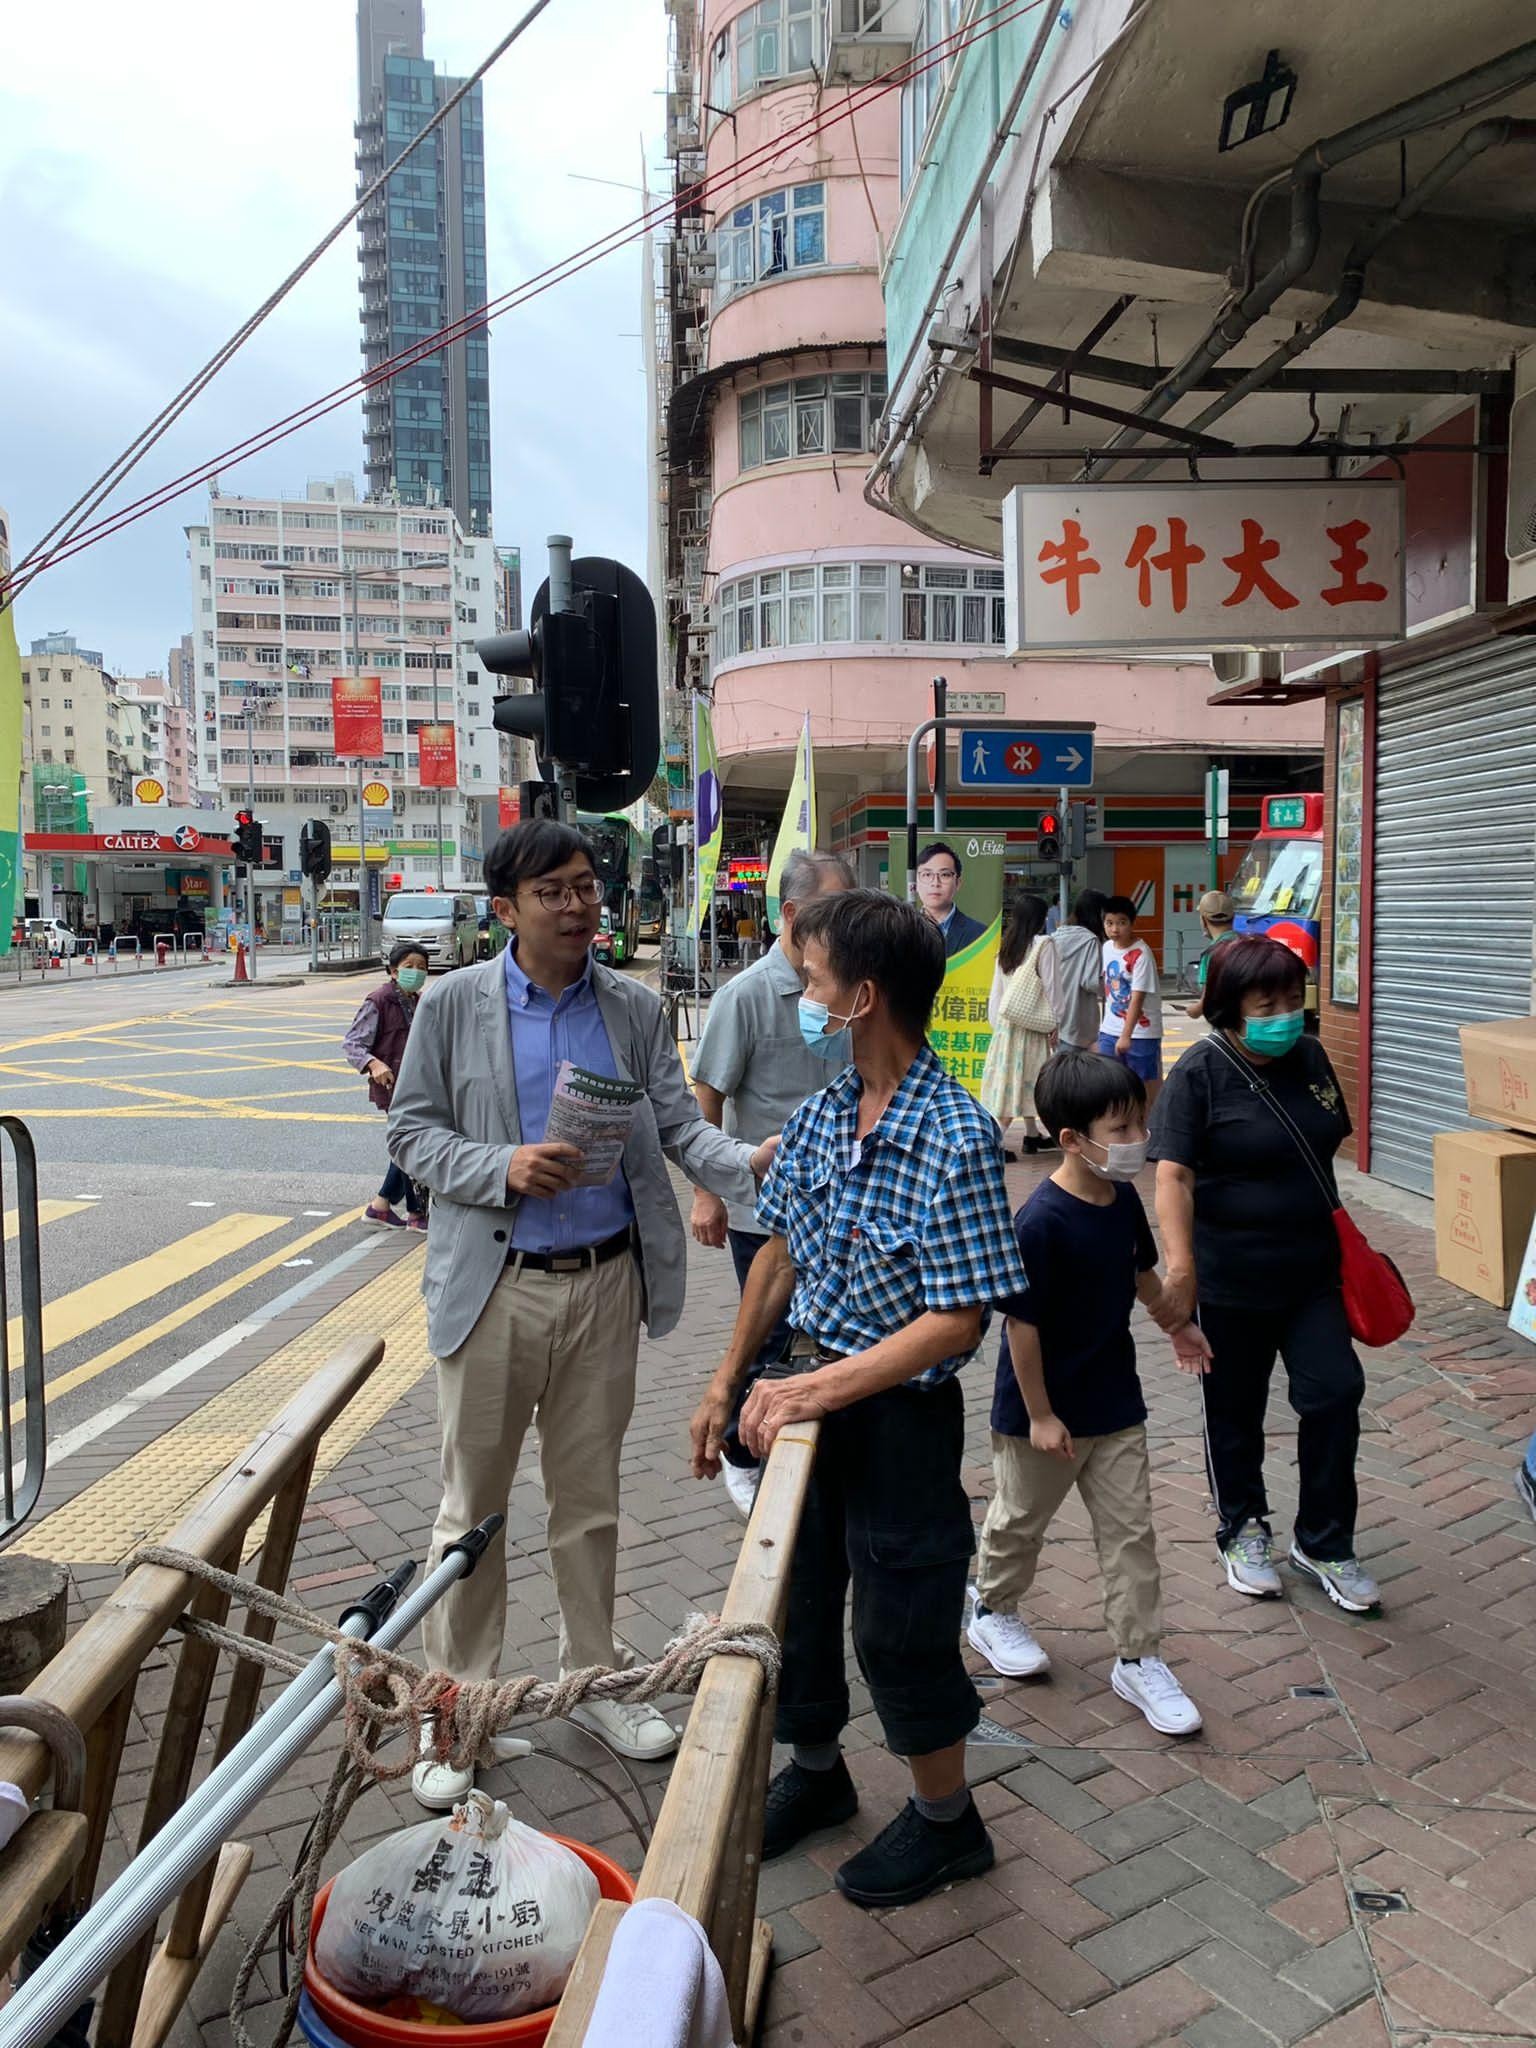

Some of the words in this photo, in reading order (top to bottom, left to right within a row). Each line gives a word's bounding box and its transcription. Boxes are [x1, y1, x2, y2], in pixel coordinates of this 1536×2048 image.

[1037, 517, 1388, 616] 牛什大王
[104, 835, 160, 849] CALTEX
[185, 875, 205, 890] Star
[482, 1932, 545, 1954] KITCHEN
